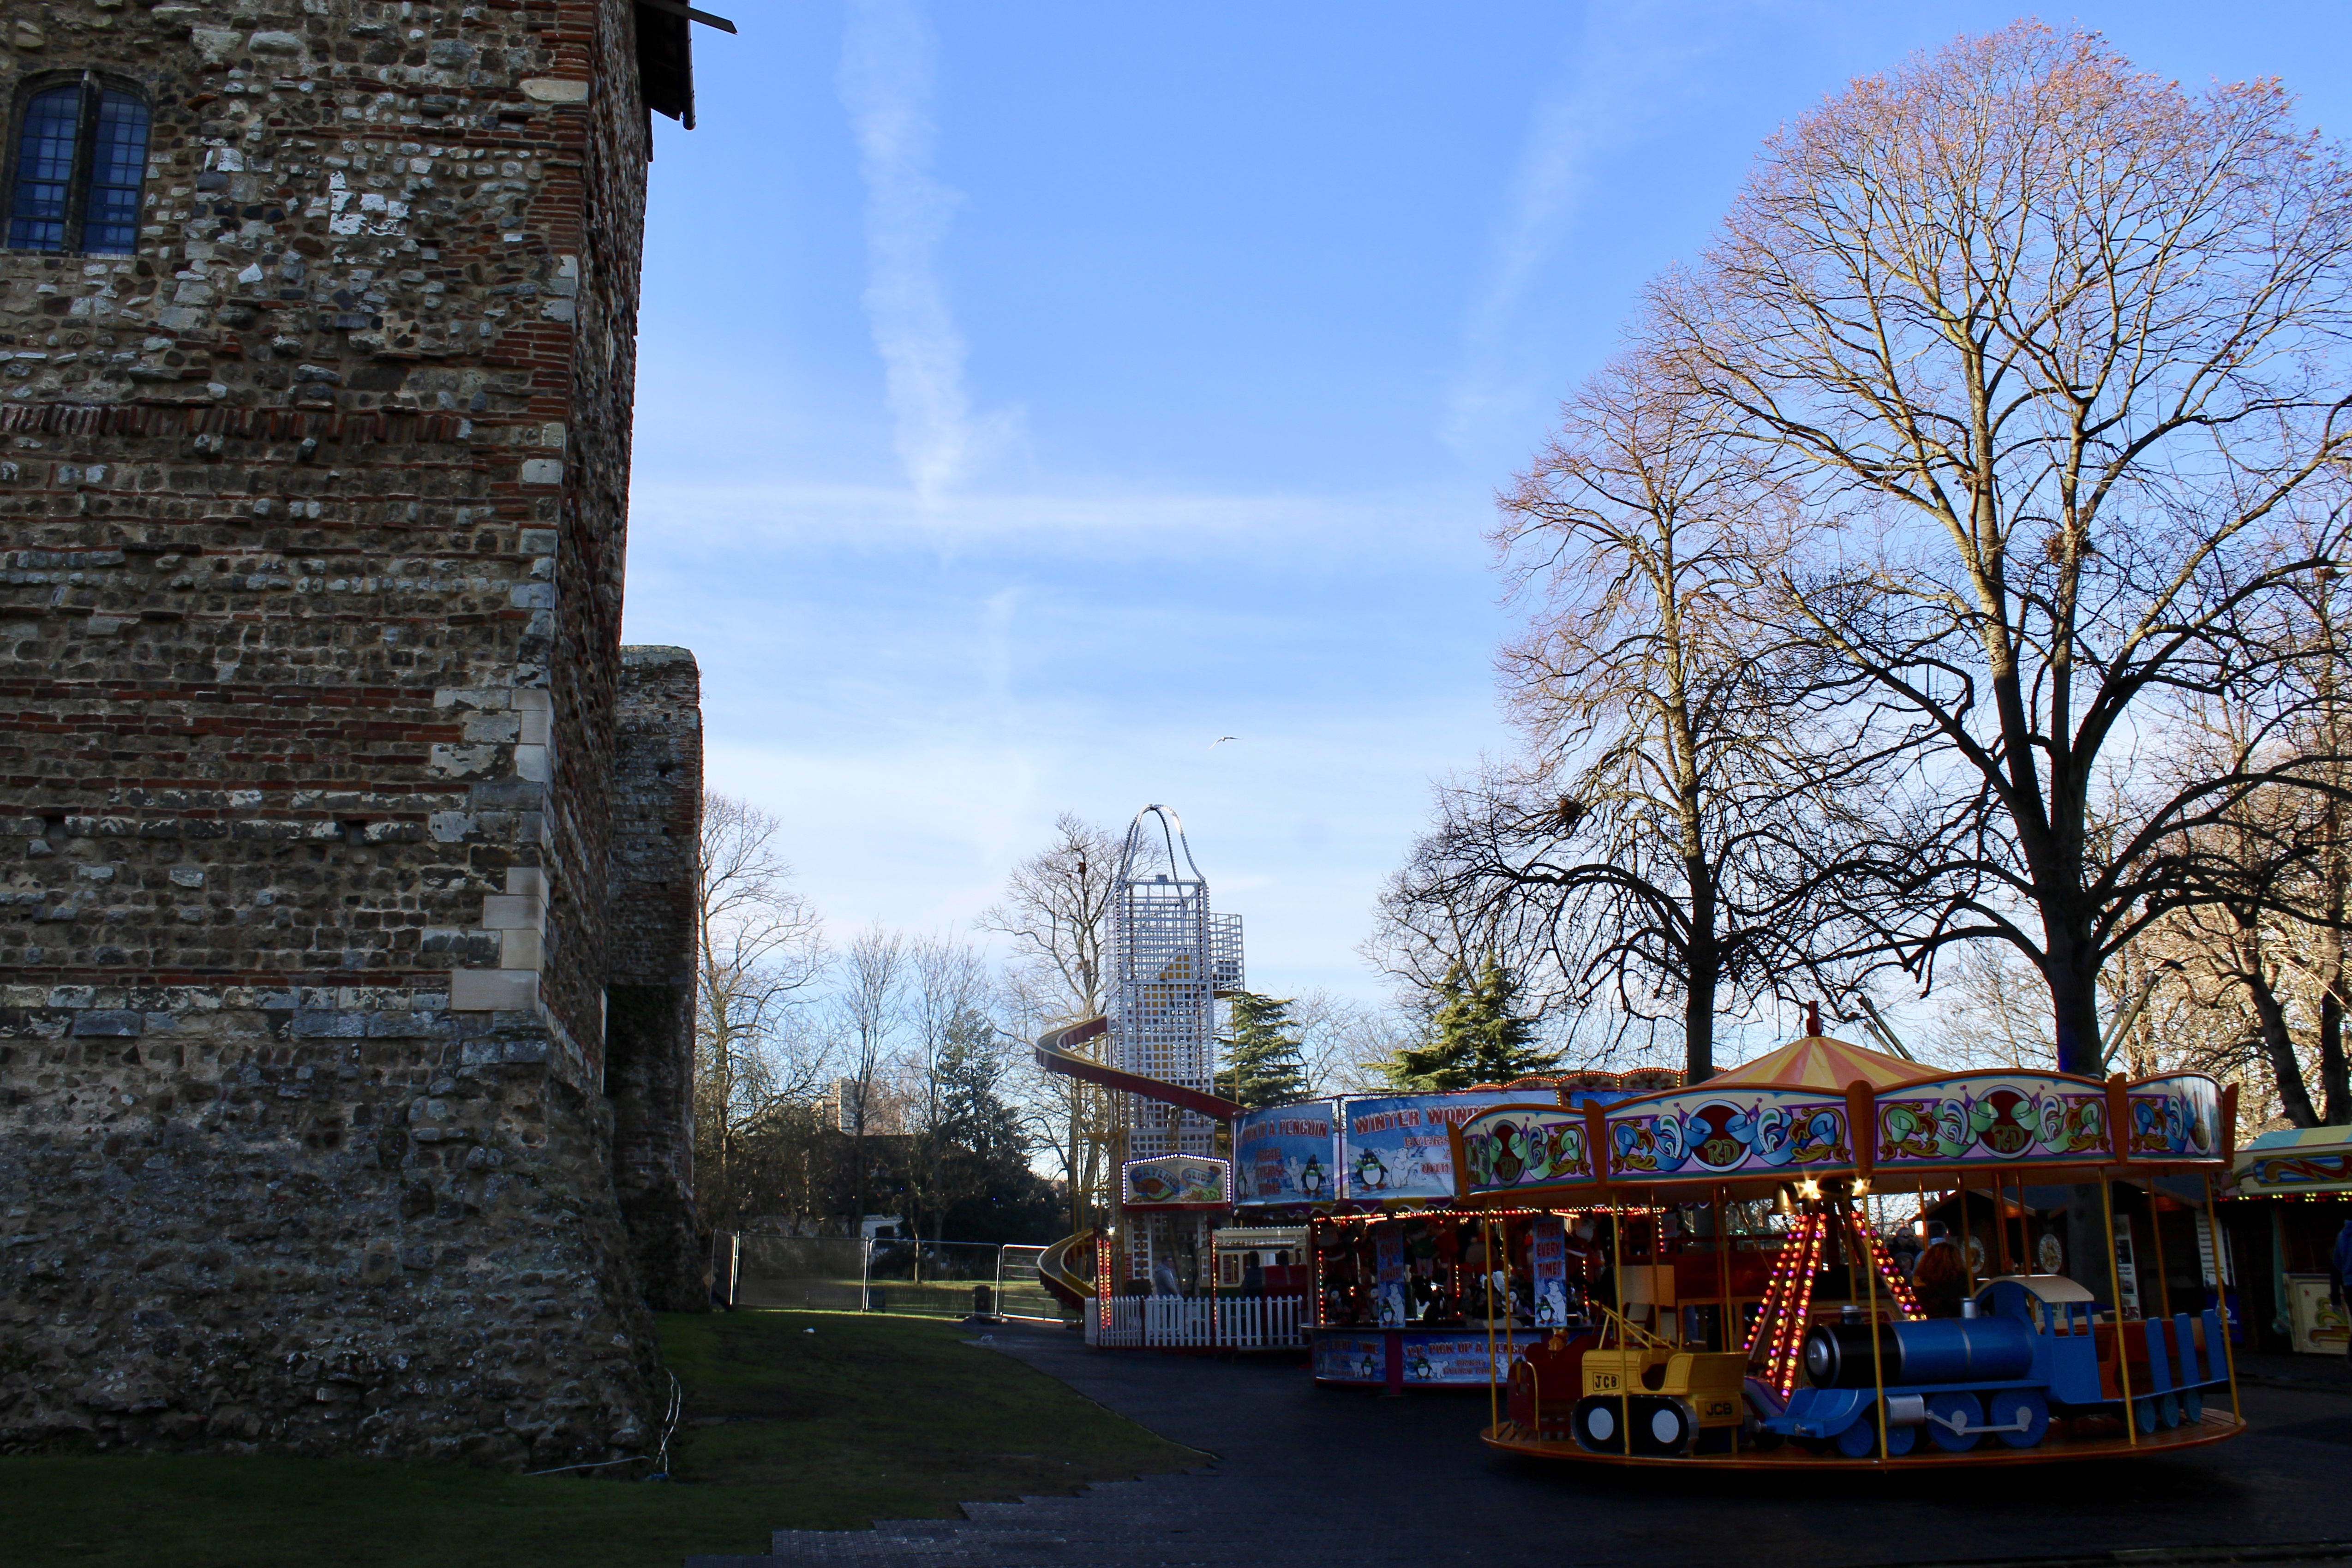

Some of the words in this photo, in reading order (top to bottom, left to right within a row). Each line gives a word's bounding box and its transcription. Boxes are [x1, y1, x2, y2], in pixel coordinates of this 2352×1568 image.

[1353, 1108, 1420, 1136] WINTER
[1425, 1103, 1487, 1125] WOND
[1269, 1119, 1276, 1137] A
[1279, 1117, 1328, 1138] PENGUIN
[1421, 1162, 1452, 1174] WIN
[1537, 1241, 1561, 1257] EVERY
[1538, 1260, 1562, 1278] TIME!
[1428, 1342, 1454, 1354] PICK
[1457, 1341, 1472, 1353] UP
[1475, 1341, 1484, 1353] A
[1595, 1376, 1617, 1388] JCB
[1707, 1403, 1733, 1416] JCB
